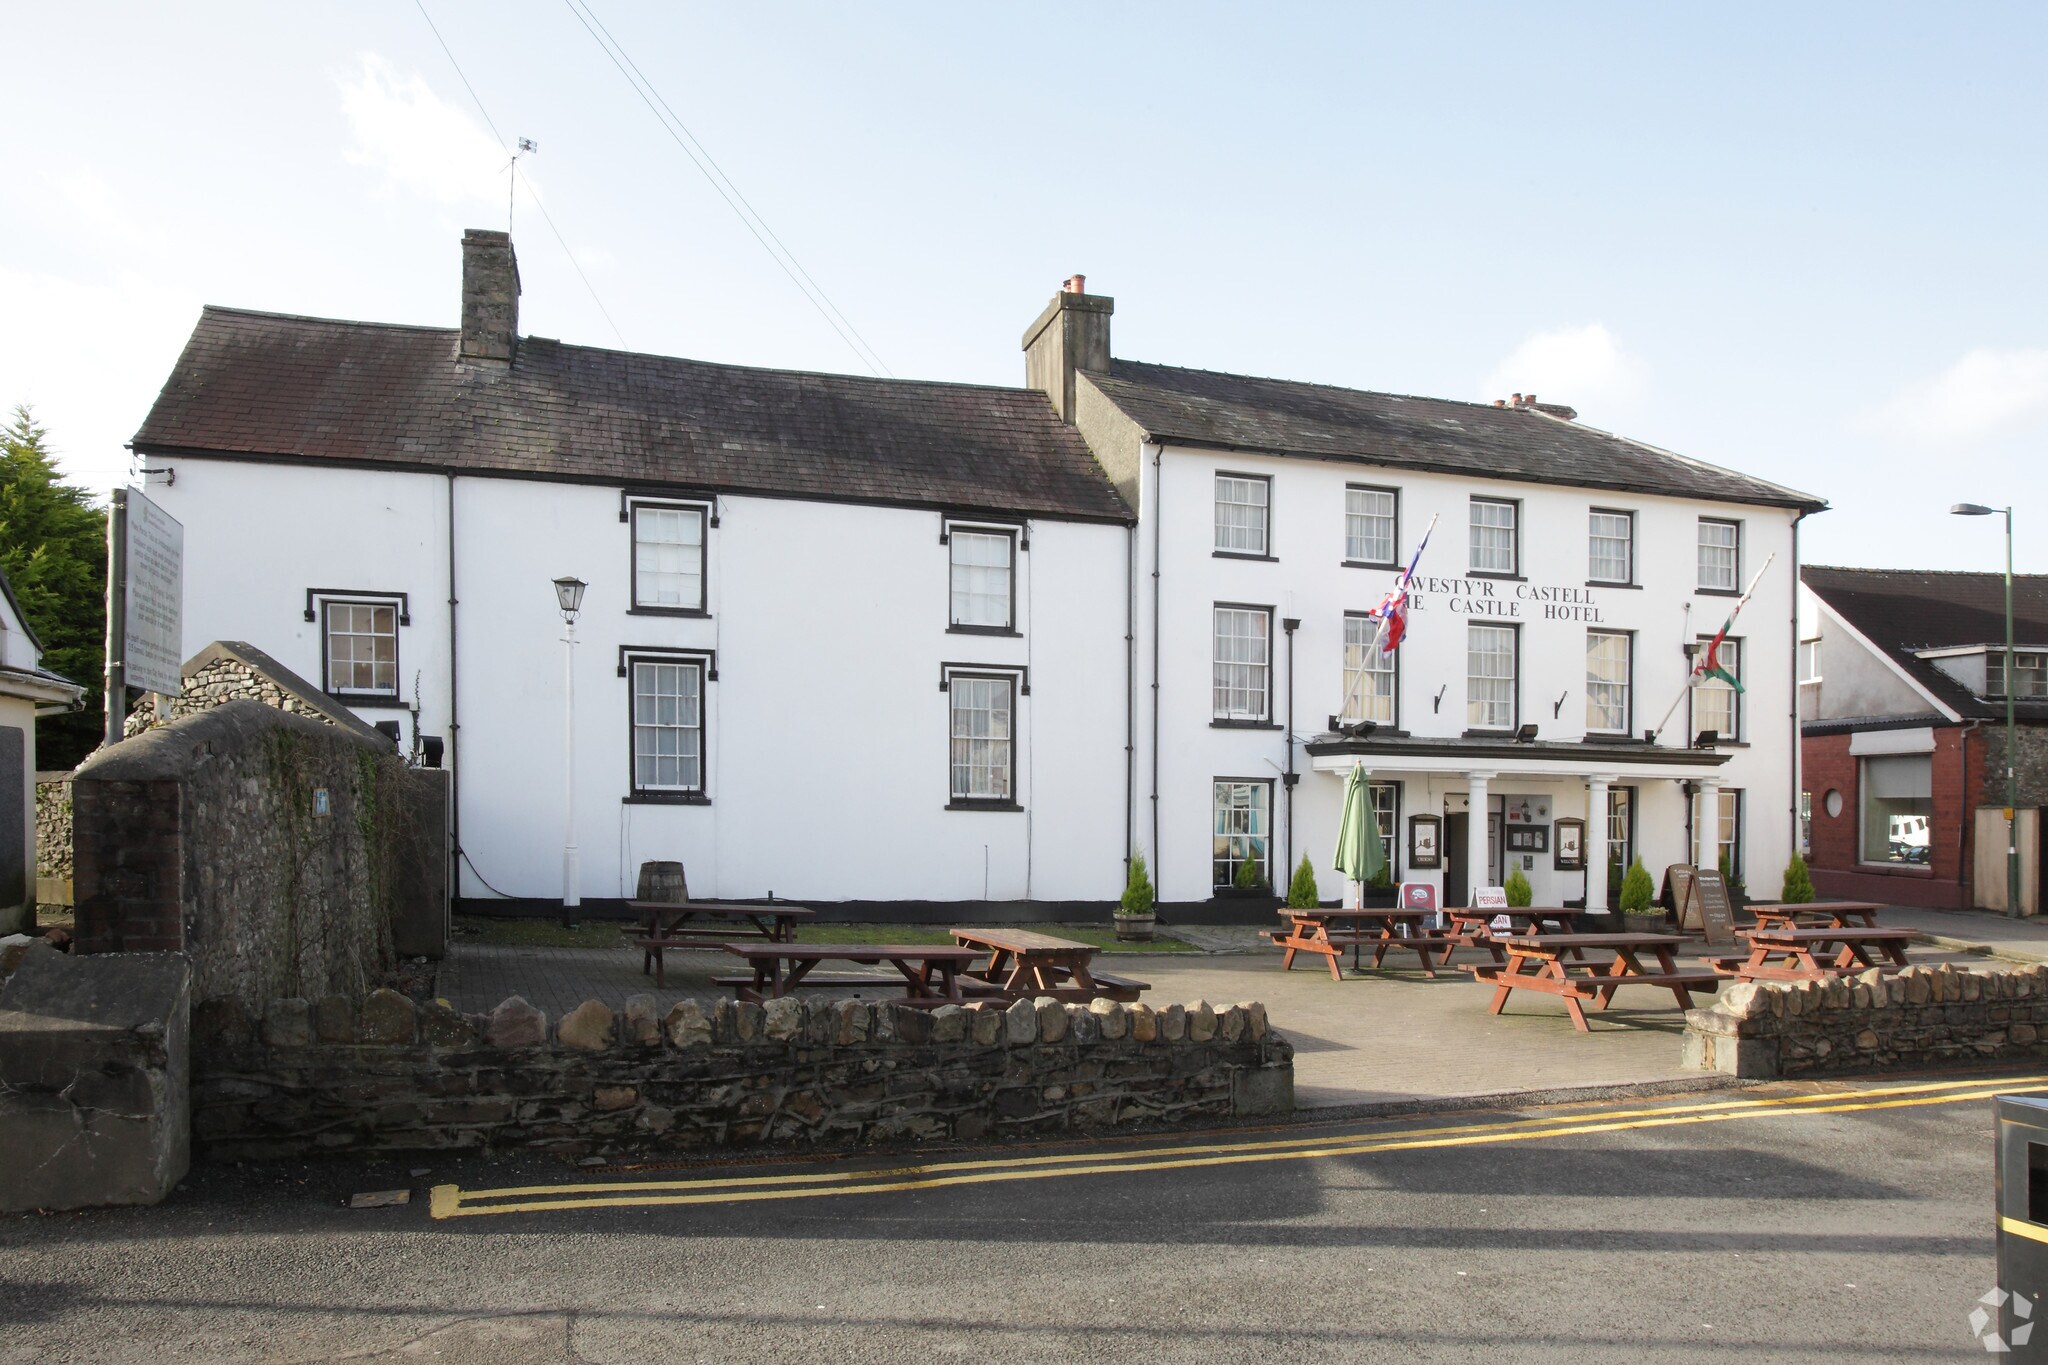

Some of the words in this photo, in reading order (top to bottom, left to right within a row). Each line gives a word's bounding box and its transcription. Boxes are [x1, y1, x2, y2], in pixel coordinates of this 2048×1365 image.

[1516, 584, 1595, 604] CASTELL
[1449, 597, 1520, 617] CASTLE
[1544, 604, 1605, 623] HOTEL
[1478, 895, 1506, 904] PERSIAN
[1493, 915, 1508, 924] GAN
